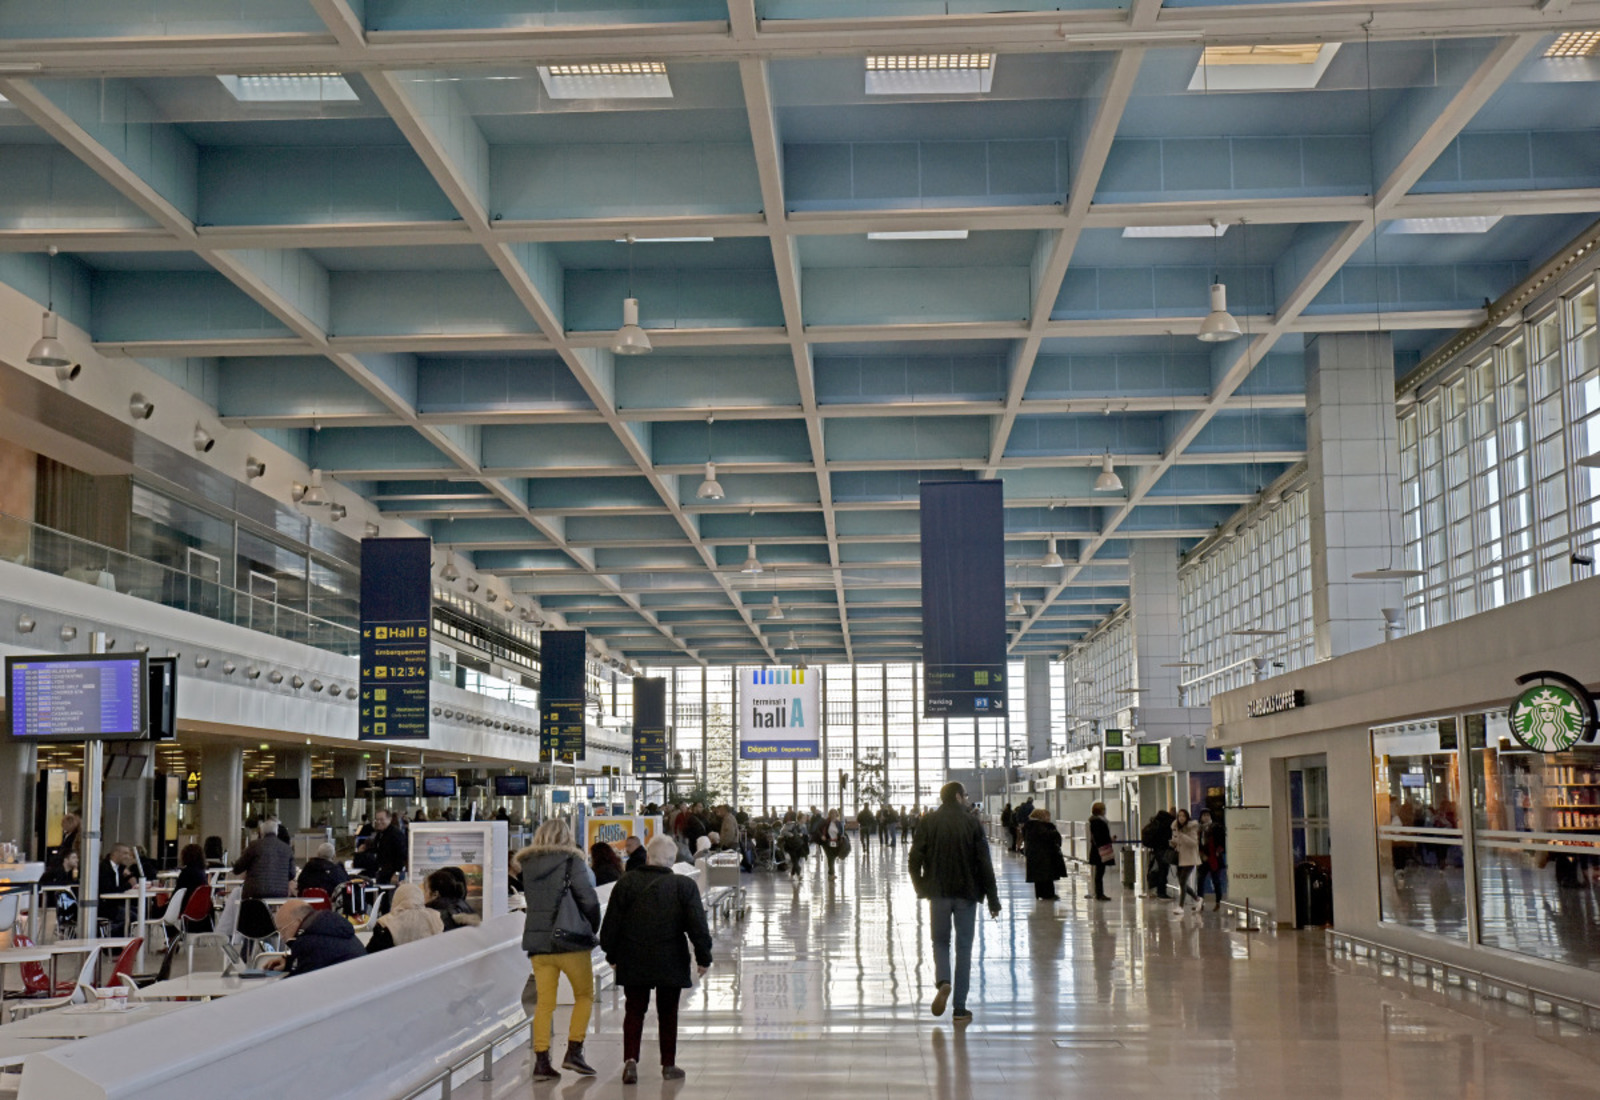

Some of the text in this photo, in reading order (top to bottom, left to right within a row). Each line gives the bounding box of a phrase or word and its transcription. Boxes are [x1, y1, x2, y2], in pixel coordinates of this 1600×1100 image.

[389, 627, 427, 638] Hall B
[753, 698, 781, 706] terminal
[928, 699, 953, 707] Parking
[753, 698, 805, 729] hall A
